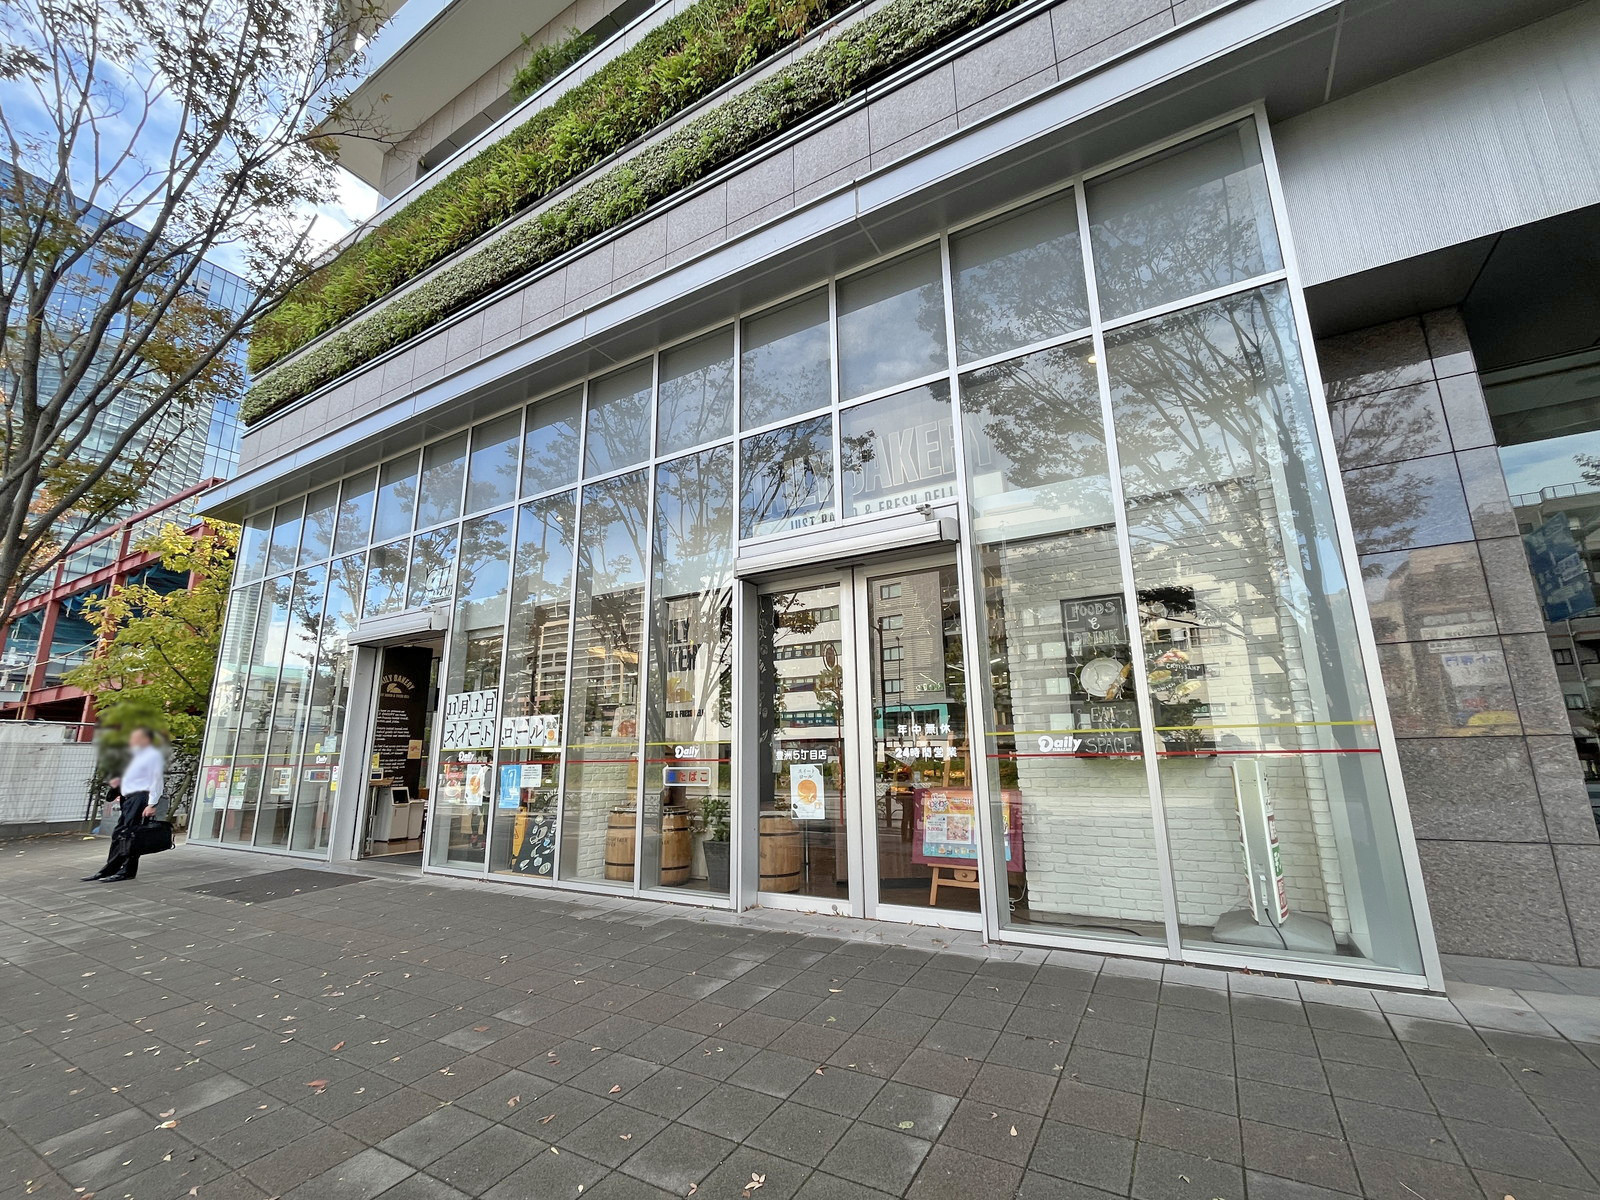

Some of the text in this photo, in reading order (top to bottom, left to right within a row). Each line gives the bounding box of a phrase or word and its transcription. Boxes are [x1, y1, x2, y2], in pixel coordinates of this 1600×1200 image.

[1071, 602, 1116, 618] FOODS
[1091, 706, 1117, 723] EAT
[444, 725, 543, 743] スイート ロール
[897, 723, 951, 736] 年中無休
[1038, 735, 1083, 752] Daily
[1086, 736, 1134, 753] SPACE
[675, 745, 700, 759] Daily
[895, 746, 958, 758] 24時間営業
[678, 770, 709, 782] たばこ
